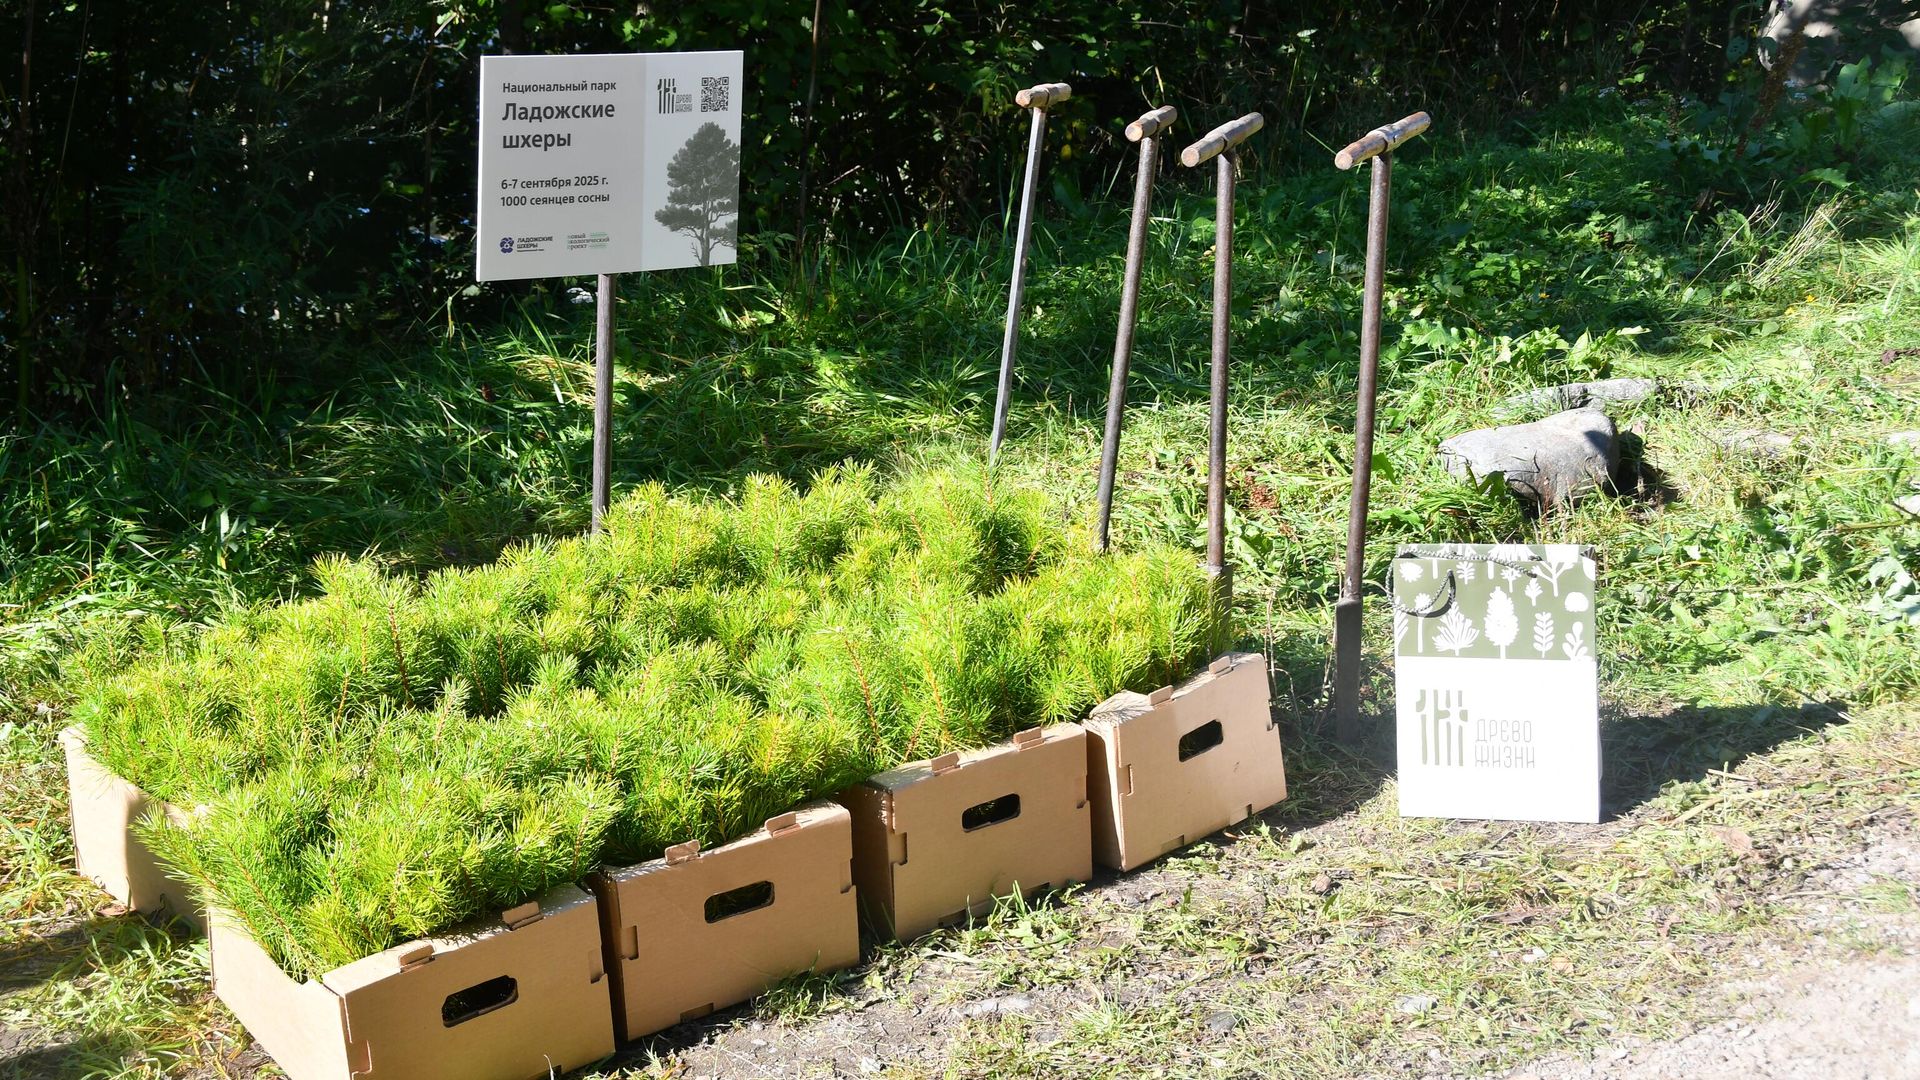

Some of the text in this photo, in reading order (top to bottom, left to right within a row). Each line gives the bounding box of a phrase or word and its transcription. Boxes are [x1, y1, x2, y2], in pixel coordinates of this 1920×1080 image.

[502, 80, 617, 93] Национальный парк
[502, 102, 615, 122] Ладожские
[502, 133, 571, 152] шхеры
[501, 176, 609, 190] 6-7 сентября 2025 г.
[500, 193, 610, 207] 1000 сеянцев сосны
[1475, 718, 1532, 743] ДРЕВО
[1474, 744, 1536, 769] ЖИЗНИ
